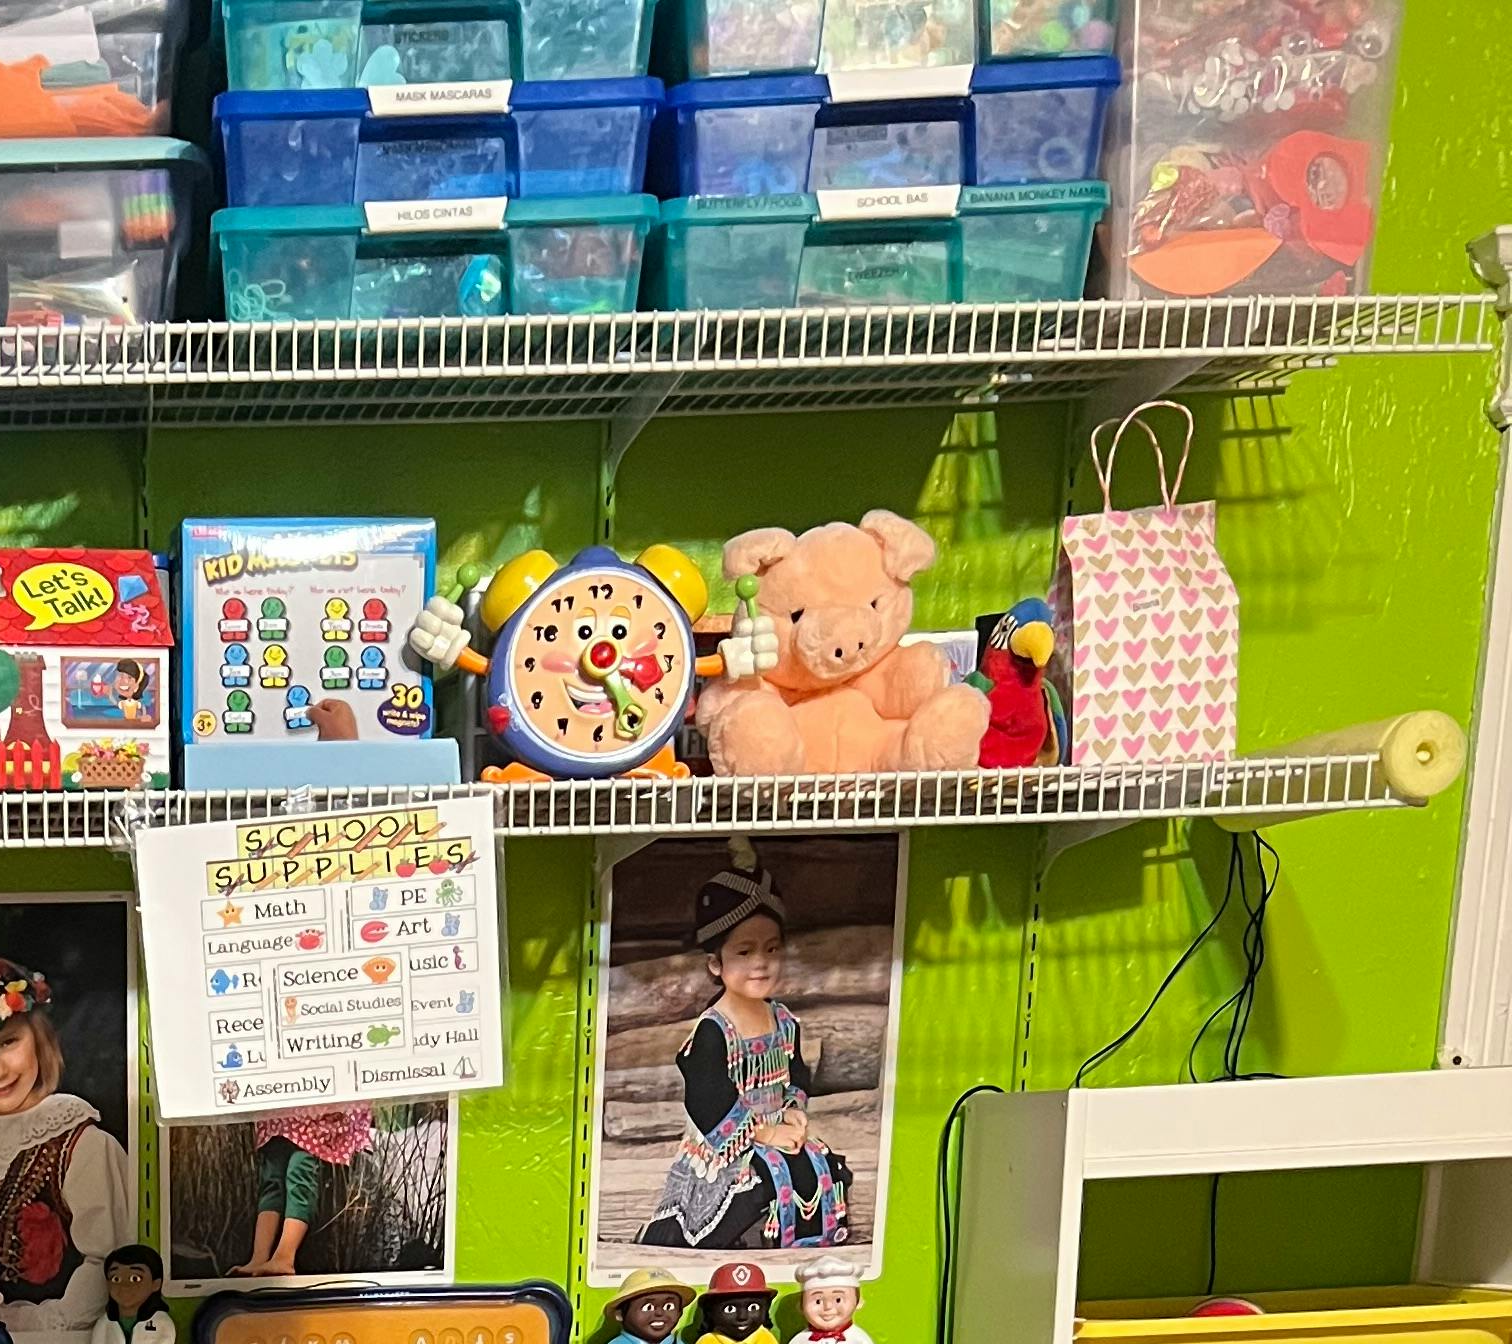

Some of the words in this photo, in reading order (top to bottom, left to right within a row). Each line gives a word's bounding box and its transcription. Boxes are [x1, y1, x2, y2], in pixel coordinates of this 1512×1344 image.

[395, 88, 427, 102] MASK
[430, 87, 492, 100] MASCARAS
[857, 195, 902, 209] SCHOOL
[970, 191, 1015, 203] BANANA
[1018, 188, 1065, 201] MONKEY
[397, 209, 430, 221] HILOS
[433, 206, 473, 218] CINTAS
[204, 552, 244, 582] KID
[20, 569, 88, 600] Let's
[588, 583, 614, 600] 12
[43, 588, 108, 618] Talk!
[551, 596, 575, 613] 11
[524, 657, 536, 672] 9
[390, 683, 424, 710] 30
[531, 691, 543, 709] 8
[593, 725, 604, 742] 6
[245, 813, 430, 851] SCHOOL
[215, 843, 464, 889] SUPPLIES
[400, 887, 427, 906] PE
[254, 899, 307, 919] Math
[396, 917, 432, 936] Art
[207, 935, 293, 955] Language
[283, 966, 358, 987] Science
[300, 1001, 343, 1016] Social
[346, 996, 402, 1013] Studies
[287, 1032, 363, 1054] Writing
[445, 1027, 479, 1043] Hall
[361, 1062, 446, 1084] Dismissal
[243, 1075, 331, 1098] Assembly
